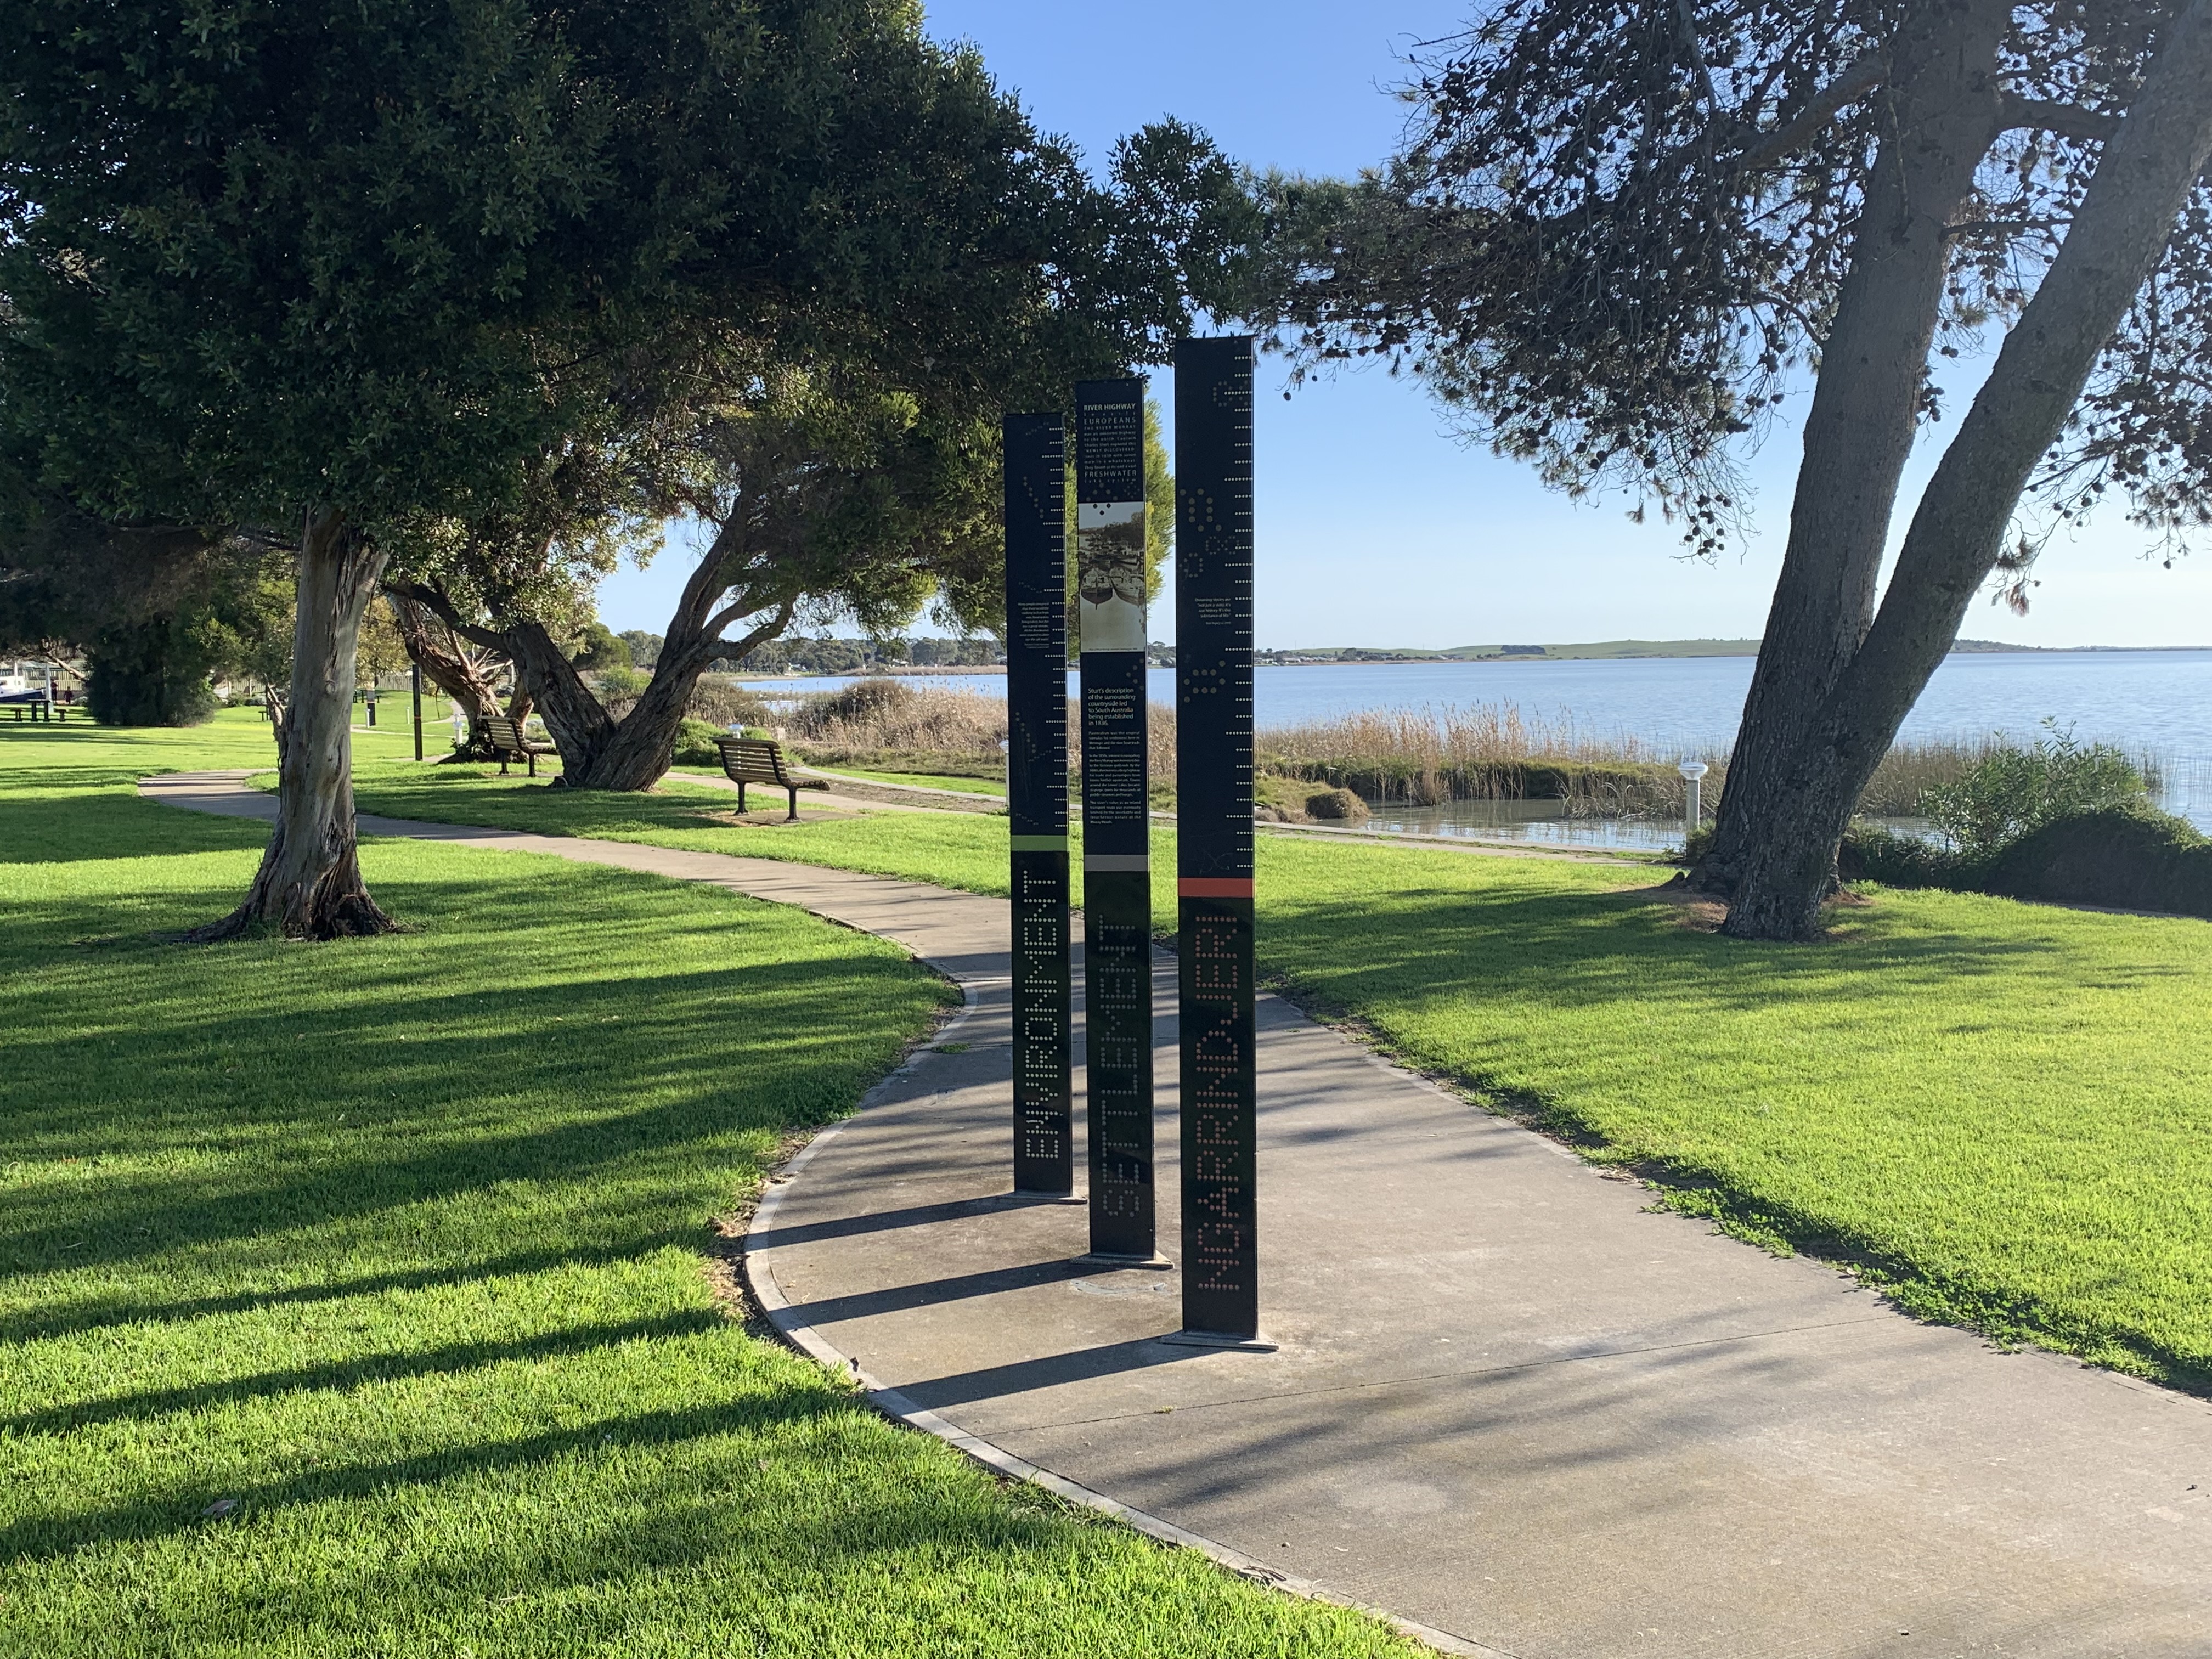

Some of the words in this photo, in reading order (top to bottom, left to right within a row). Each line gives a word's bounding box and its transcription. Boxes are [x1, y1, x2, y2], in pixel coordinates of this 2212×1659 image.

[1023, 870, 1058, 1158] ENVIRONMENT
[1099, 914, 1139, 1217] SETTLEMENT
[1195, 916, 1240, 1290] NGARRINDJERI
